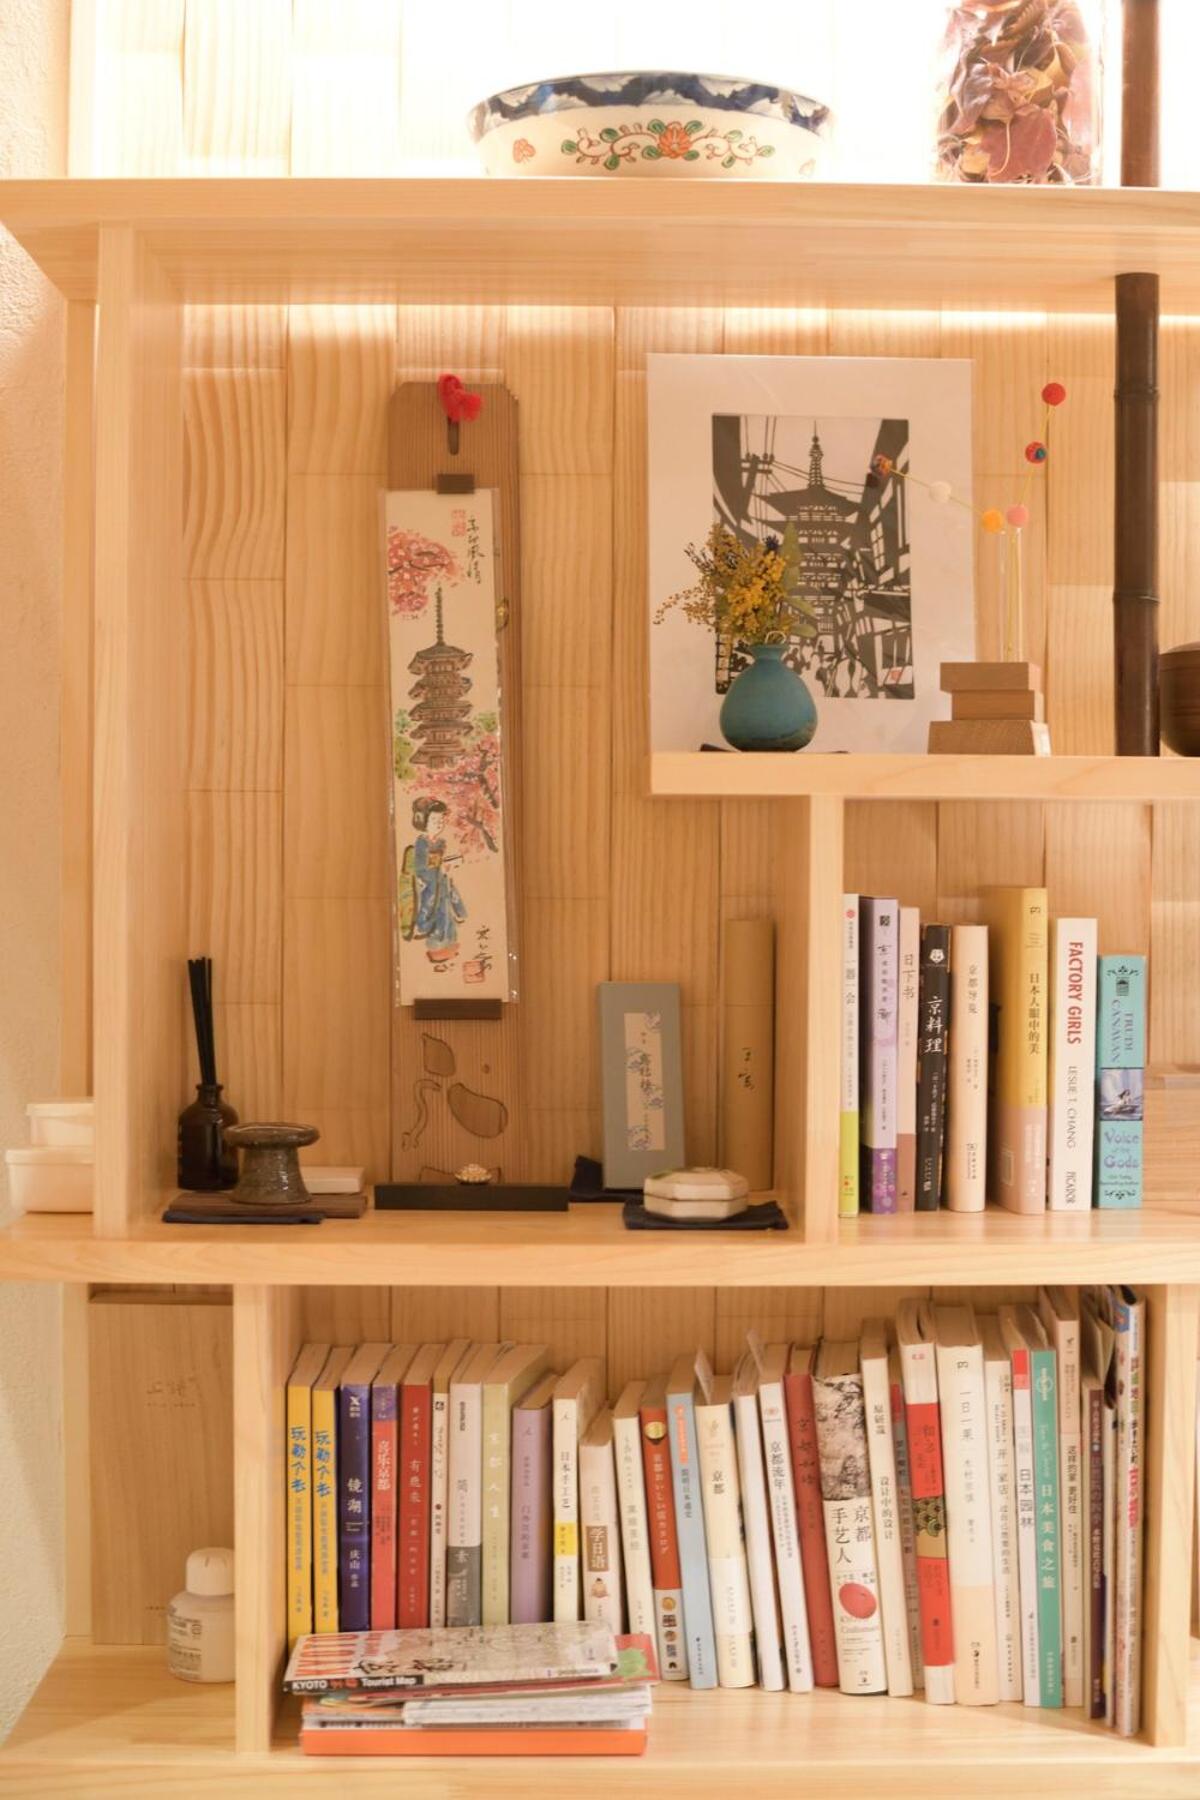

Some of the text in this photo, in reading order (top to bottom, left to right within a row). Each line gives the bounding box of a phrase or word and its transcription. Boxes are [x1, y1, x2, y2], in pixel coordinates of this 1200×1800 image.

[1028, 972, 1041, 1056] 日本人眼中的美
[1067, 941, 1084, 1045] FACTORY GIRLS
[925, 995, 943, 1053] 京料理
[1111, 999, 1121, 1063] CANAVAN
[1067, 1065, 1078, 1093] LESLIE
[1066, 1107, 1077, 1149] CHANG
[1104, 1127, 1139, 1144] Voice
[1103, 1154, 1139, 1169] Gods
[1065, 1170, 1077, 1205] PICADOR
[712, 1470, 725, 1495] 京都
[770, 1441, 785, 1490] 京都流年
[879, 1475, 893, 1540] 设计中的设计
[1020, 1468, 1034, 1527] 日本园林
[831, 1507, 852, 1564] 手艺人
[855, 1505, 871, 1542] 京都
[1041, 1483, 1056, 1589] 日本美食之旅
[292, 1680, 328, 1690] KYOTO
[361, 1677, 394, 1688] Tourist
[396, 1676, 417, 1686] Map
